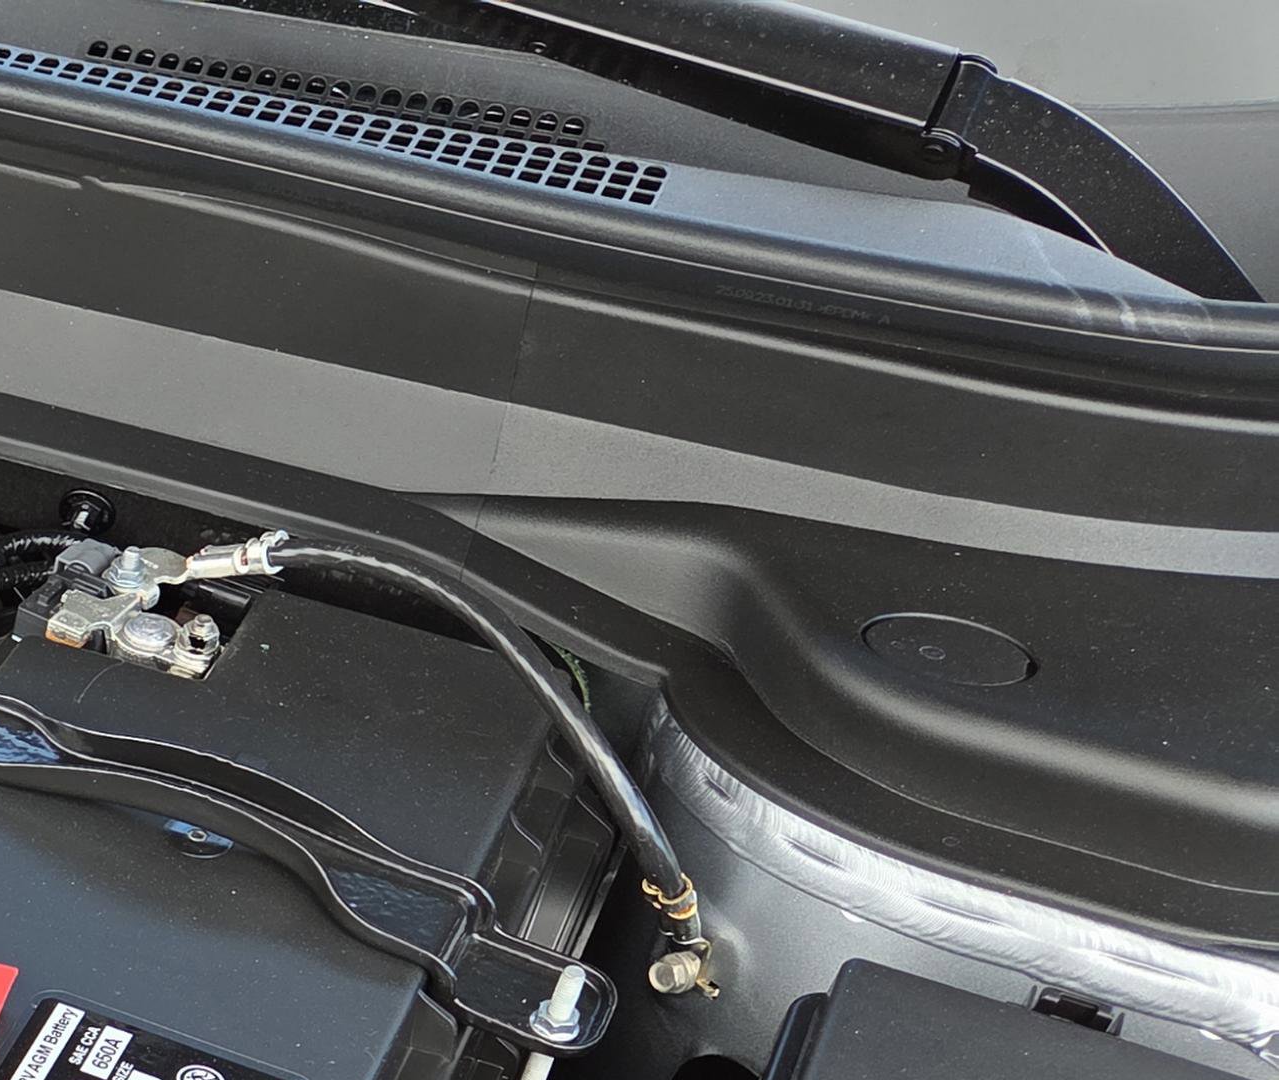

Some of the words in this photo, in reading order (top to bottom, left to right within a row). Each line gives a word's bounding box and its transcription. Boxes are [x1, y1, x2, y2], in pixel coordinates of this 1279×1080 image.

[43, 1008, 78, 1045] Battery
[68, 1044, 86, 1066] SAE
[80, 1026, 101, 1047] CCA
[92, 1038, 123, 1070] 650A
